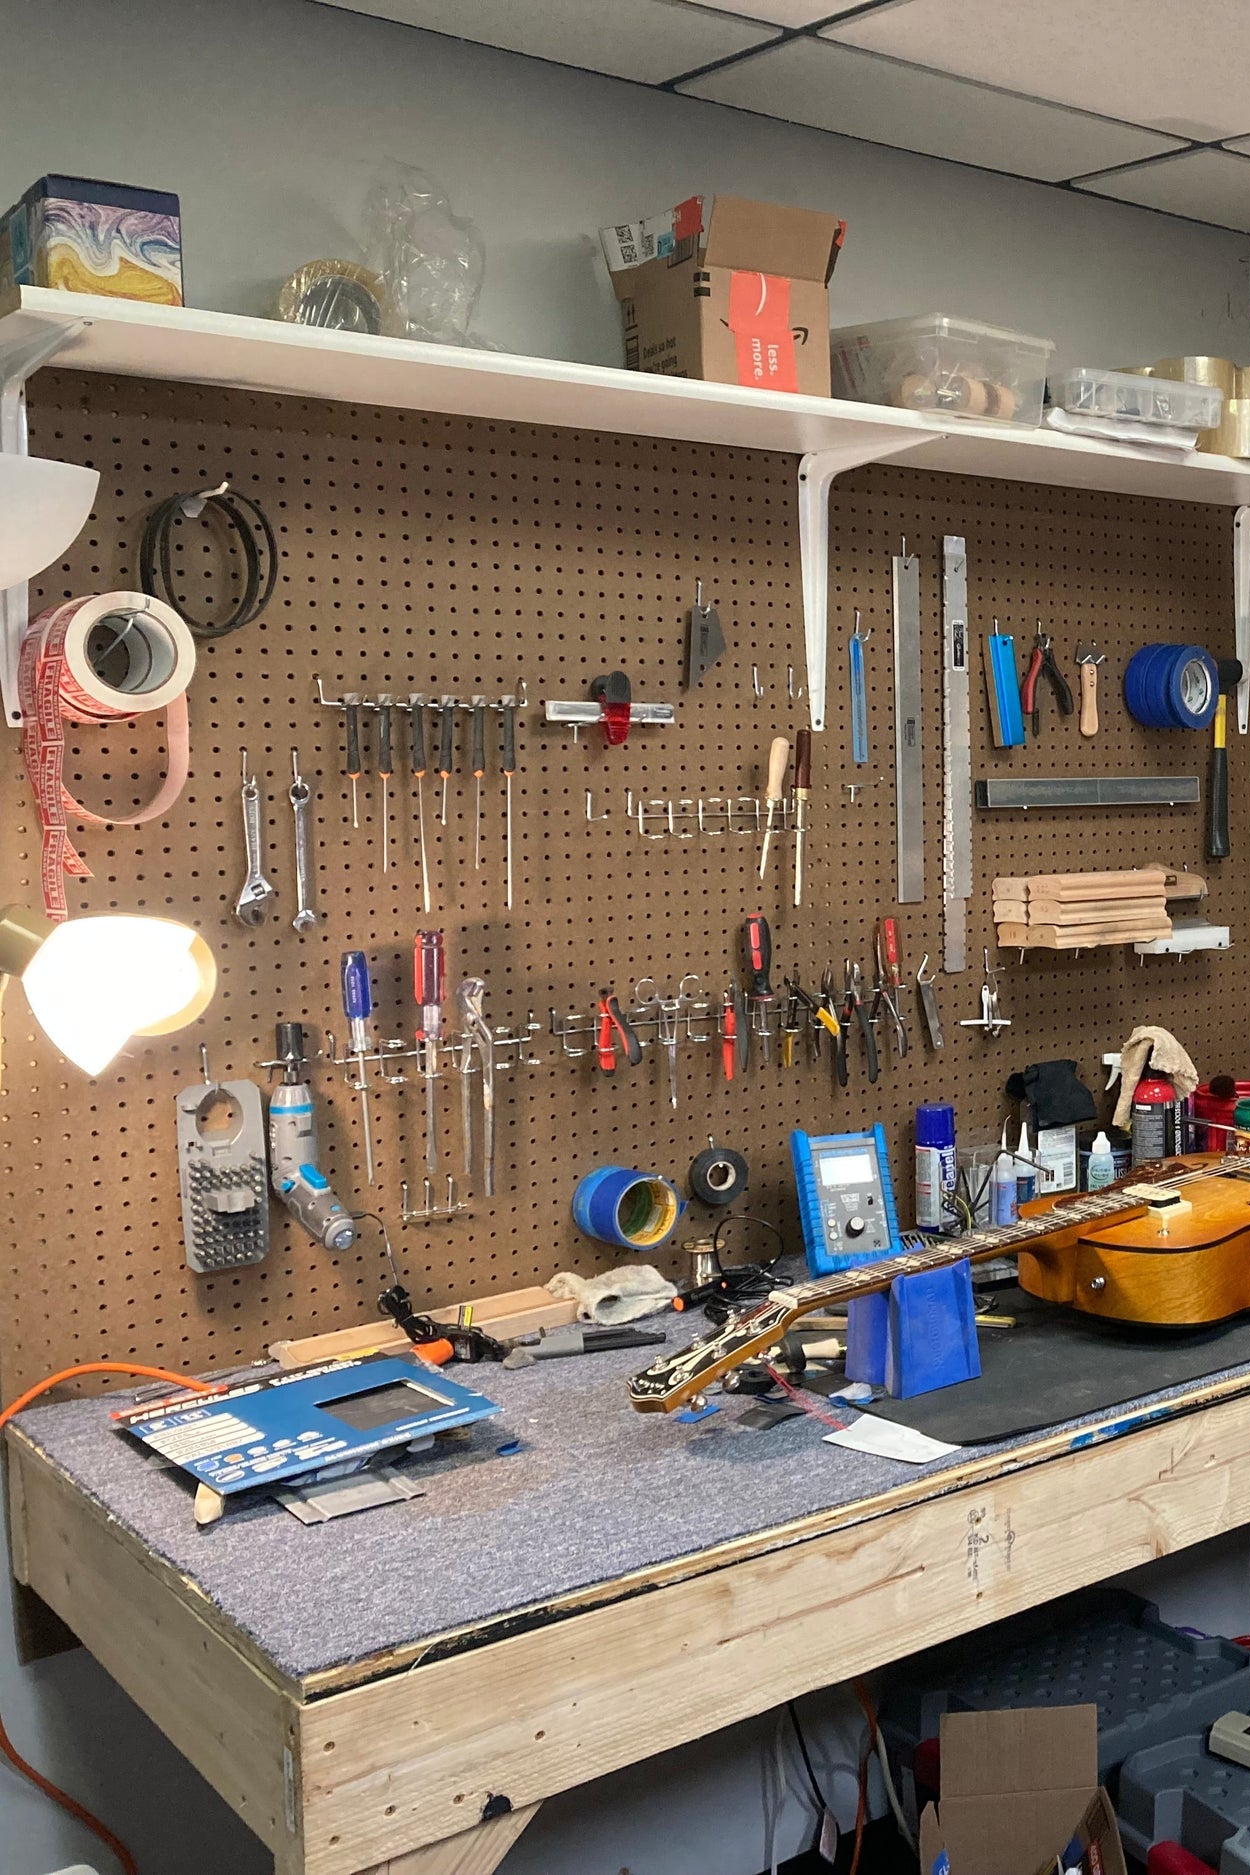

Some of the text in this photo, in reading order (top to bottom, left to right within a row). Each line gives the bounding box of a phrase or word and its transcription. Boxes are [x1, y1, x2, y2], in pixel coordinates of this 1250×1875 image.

[752, 338, 763, 380] more.
[768, 344, 779, 375] less.
[44, 664, 56, 738] FRAGILE
[46, 749, 58, 823] FRAGILE
[48, 833, 59, 906] FRAGILE
